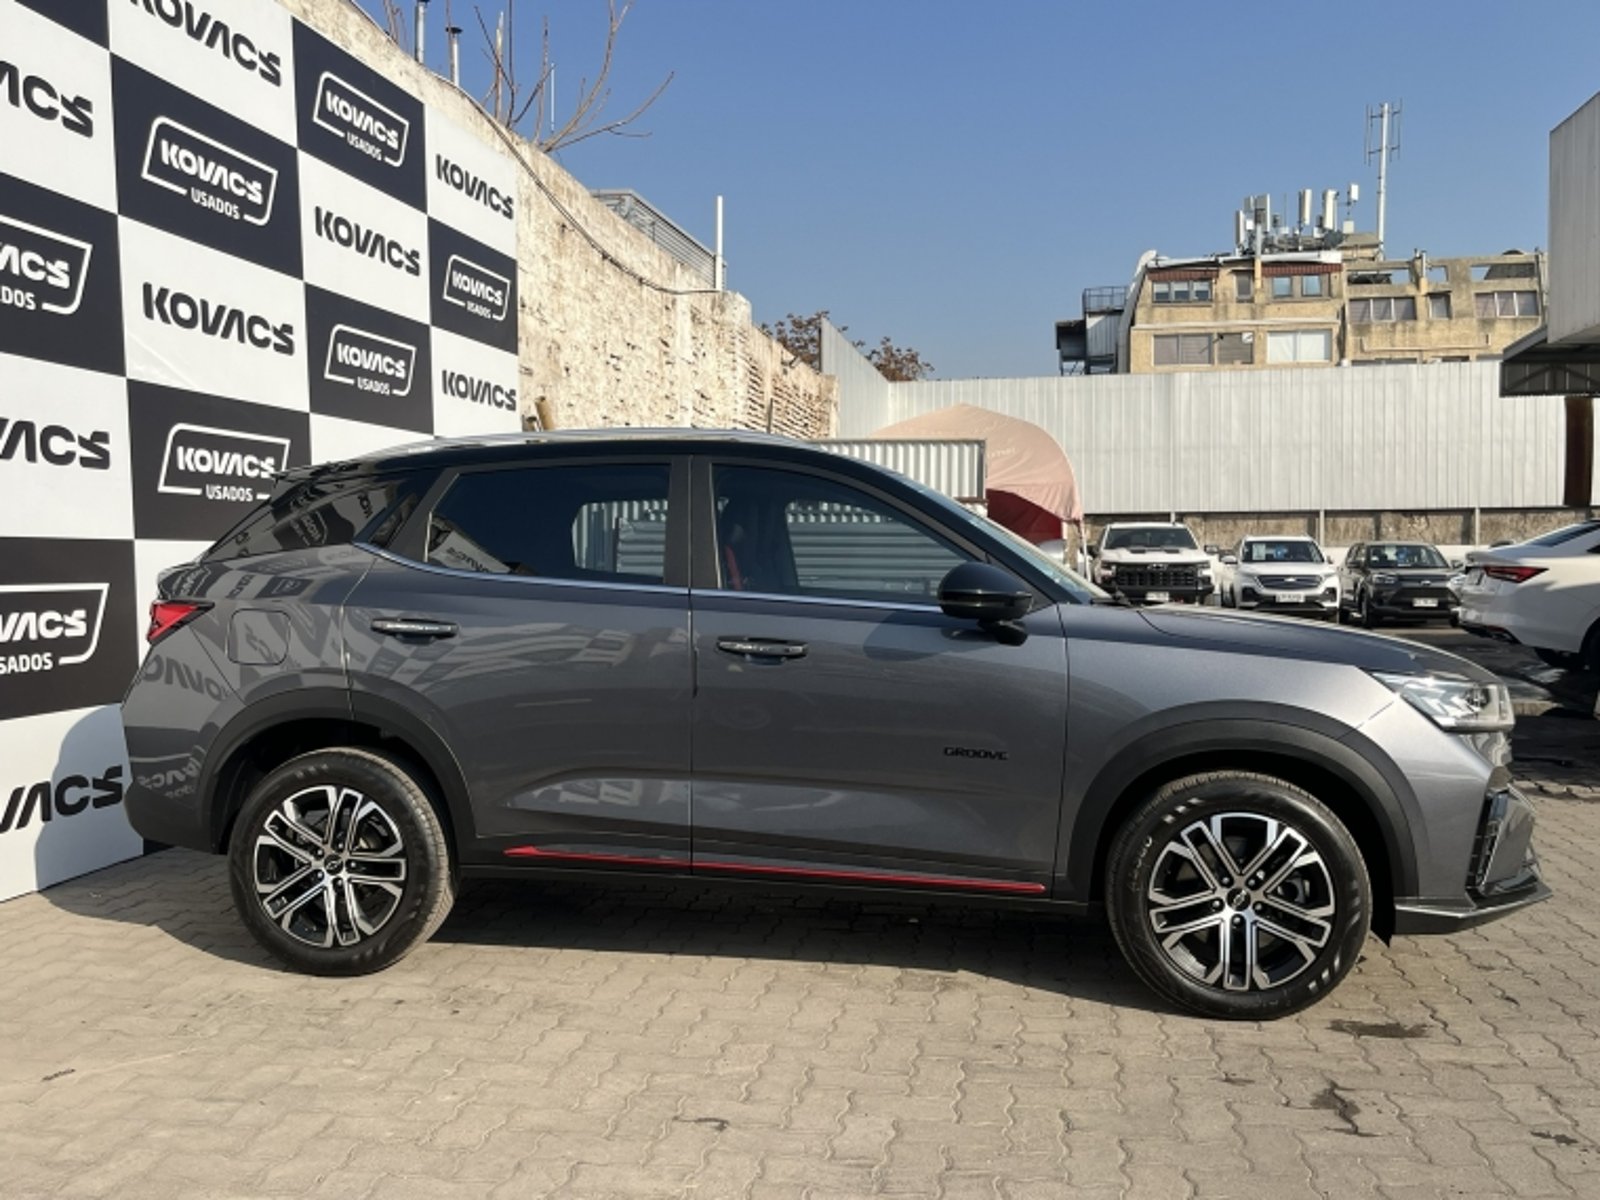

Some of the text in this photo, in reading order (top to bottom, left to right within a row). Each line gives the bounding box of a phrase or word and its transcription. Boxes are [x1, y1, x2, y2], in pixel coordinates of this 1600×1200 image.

[130, 0, 281, 87] OVACS
[326, 90, 399, 150] KOVACS
[347, 132, 382, 161] USADOS
[161, 139, 263, 204] KOVACS
[436, 154, 514, 220] KOVACS
[191, 187, 240, 220] USADOS
[315, 206, 420, 277] KOVACS
[0, 242, 70, 289] ACS
[0, 285, 36, 311] DOS
[452, 270, 503, 306] KOVACS
[143, 282, 295, 356] KOVACS
[466, 301, 491, 319] USADOS
[336, 342, 407, 380] KOVACS
[357, 377, 390, 396] USADOS
[442, 370, 517, 412] KOVACS
[176, 446, 275, 479] KOVACS
[205, 484, 253, 502] USADOS
[943, 746, 1008, 760] GROOVE
